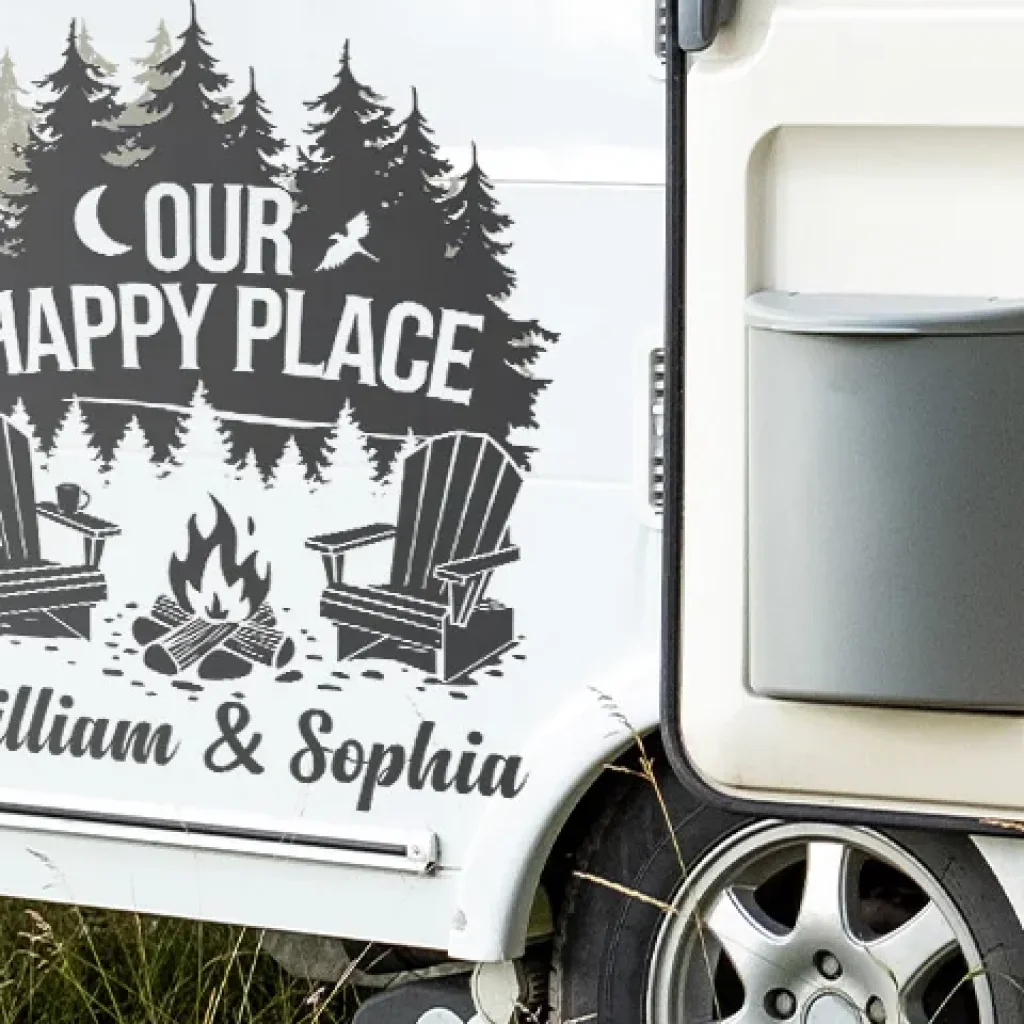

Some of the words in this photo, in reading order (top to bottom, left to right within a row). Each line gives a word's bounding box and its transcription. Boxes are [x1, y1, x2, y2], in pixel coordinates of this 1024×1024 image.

[144, 182, 293, 275] OUR
[234, 285, 485, 406] PLACE
[204, 701, 265, 775] &
[290, 708, 530, 812] Sophia
